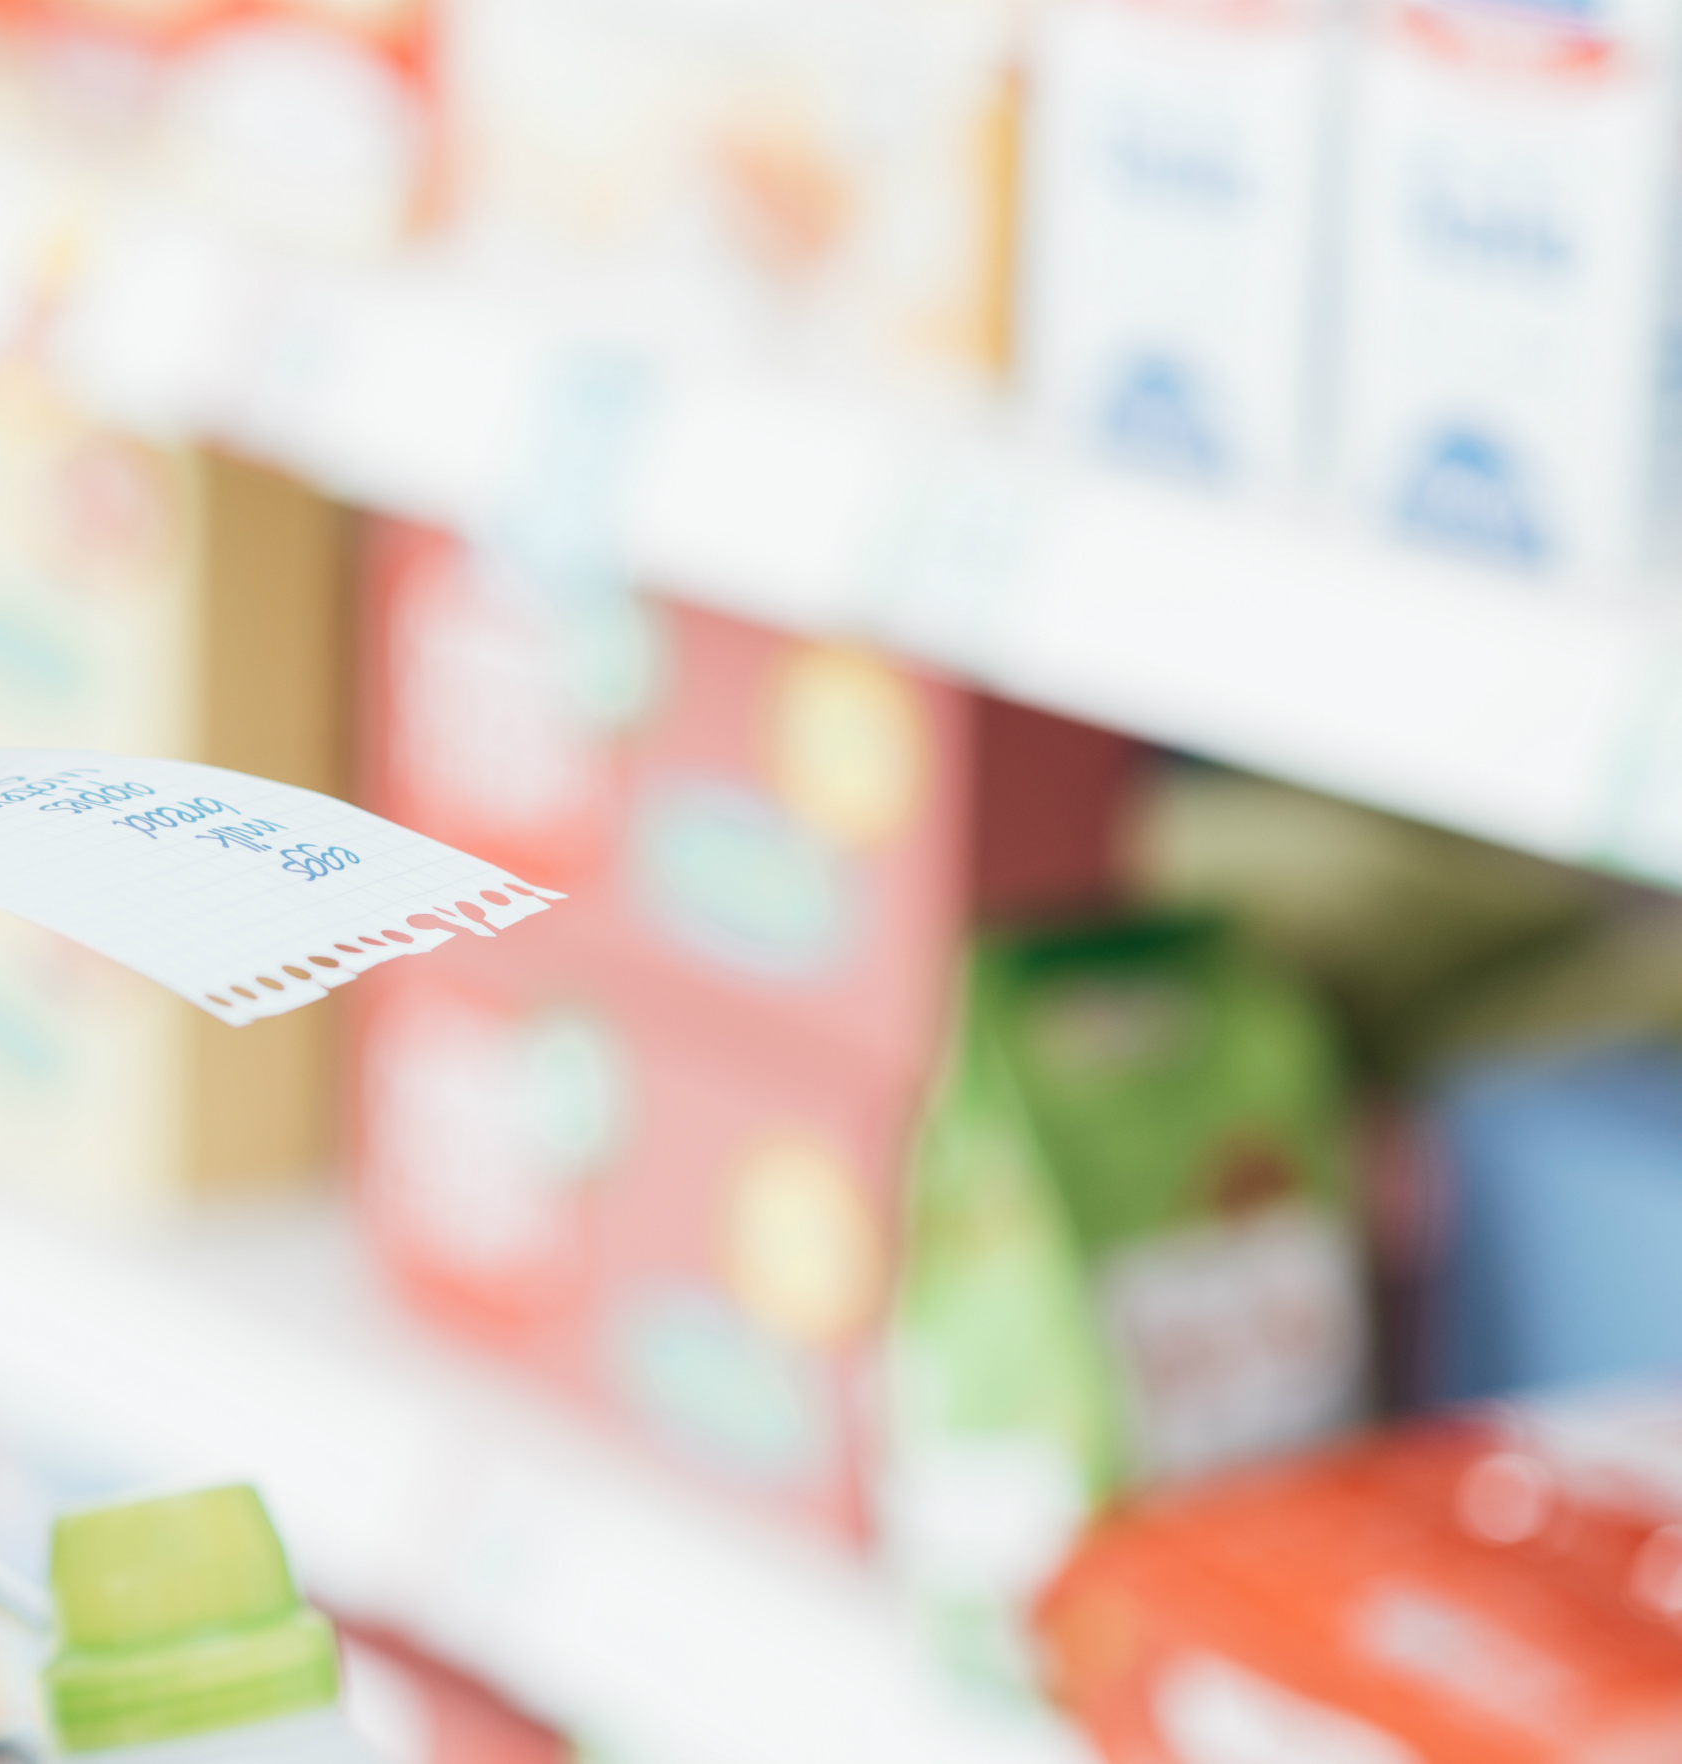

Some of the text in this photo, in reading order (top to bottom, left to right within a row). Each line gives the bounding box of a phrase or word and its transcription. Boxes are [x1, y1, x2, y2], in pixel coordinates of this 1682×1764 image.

[38, 780, 156, 814] apples
[111, 796, 242, 840] bread
[194, 817, 289, 853] milk
[279, 843, 361, 882] eggs
